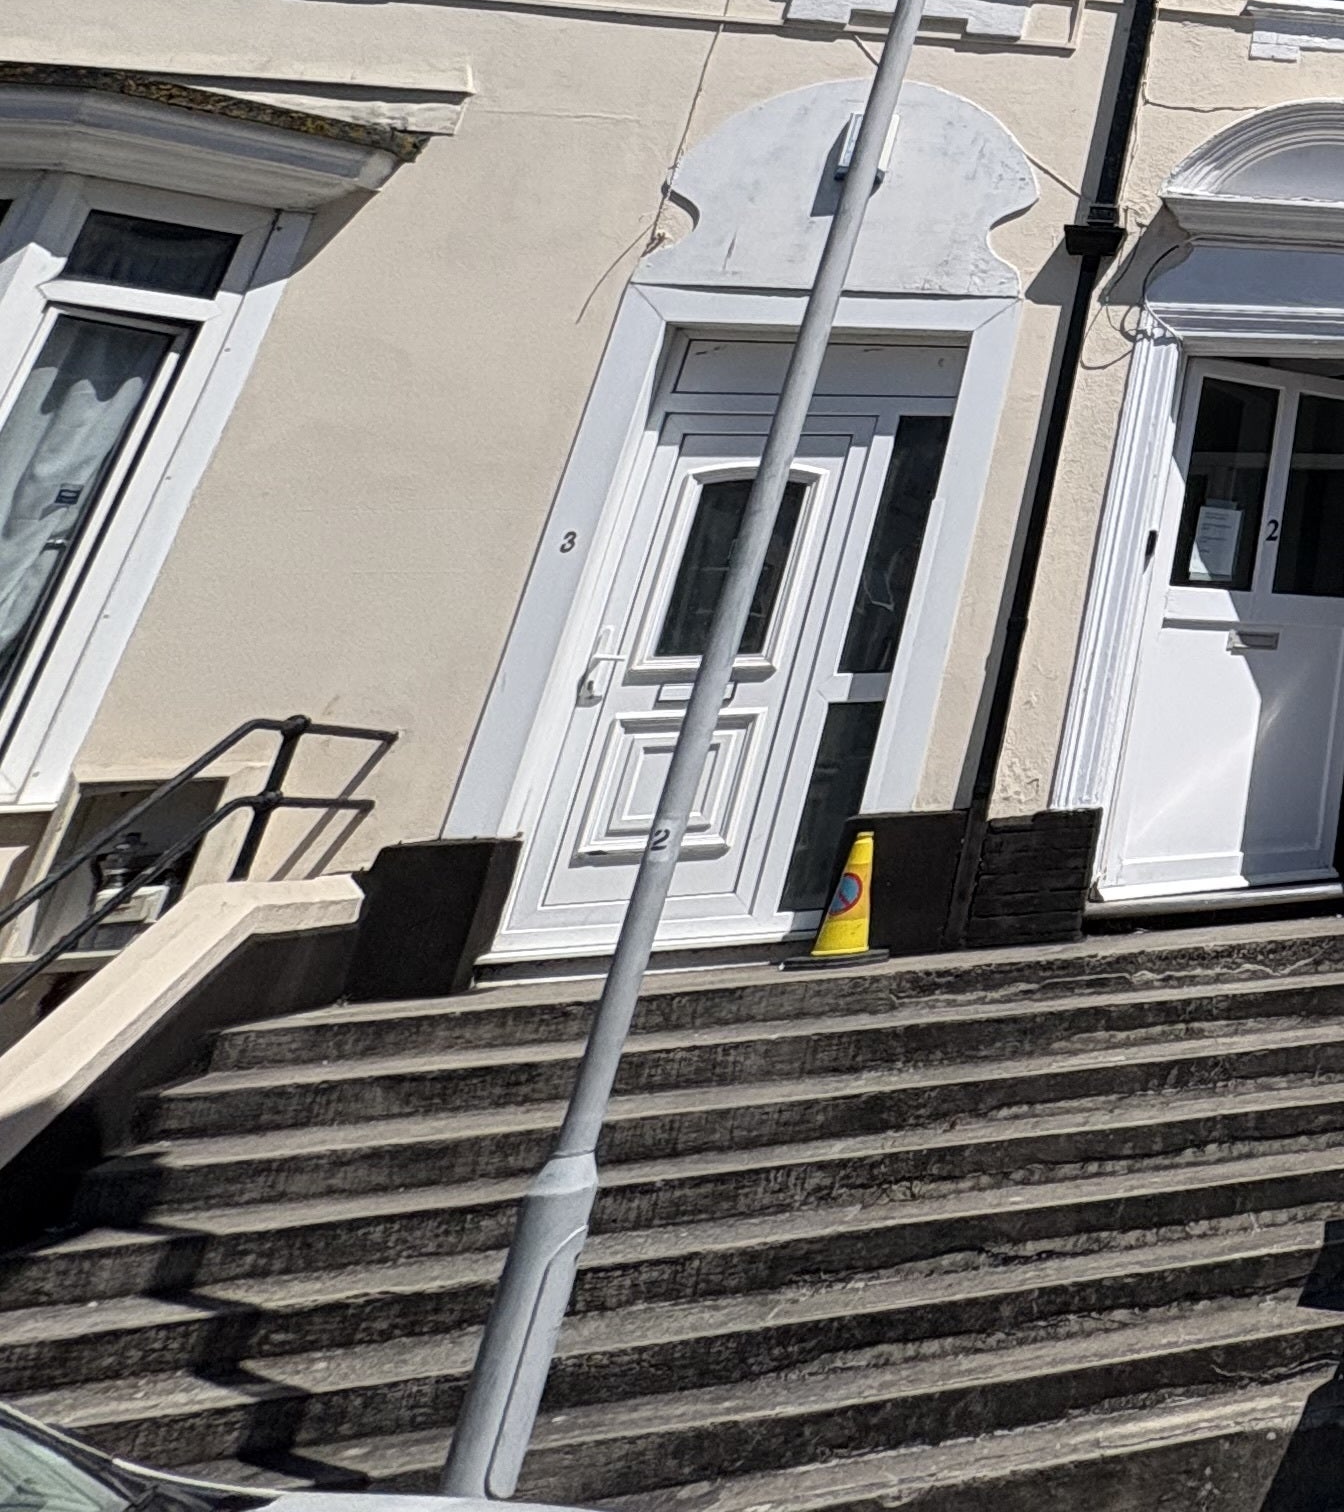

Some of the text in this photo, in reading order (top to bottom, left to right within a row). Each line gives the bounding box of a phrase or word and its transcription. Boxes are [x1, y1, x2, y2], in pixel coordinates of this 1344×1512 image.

[1265, 519, 1279, 541] 2
[560, 531, 576, 553] 3
[650, 829, 670, 851] 2
